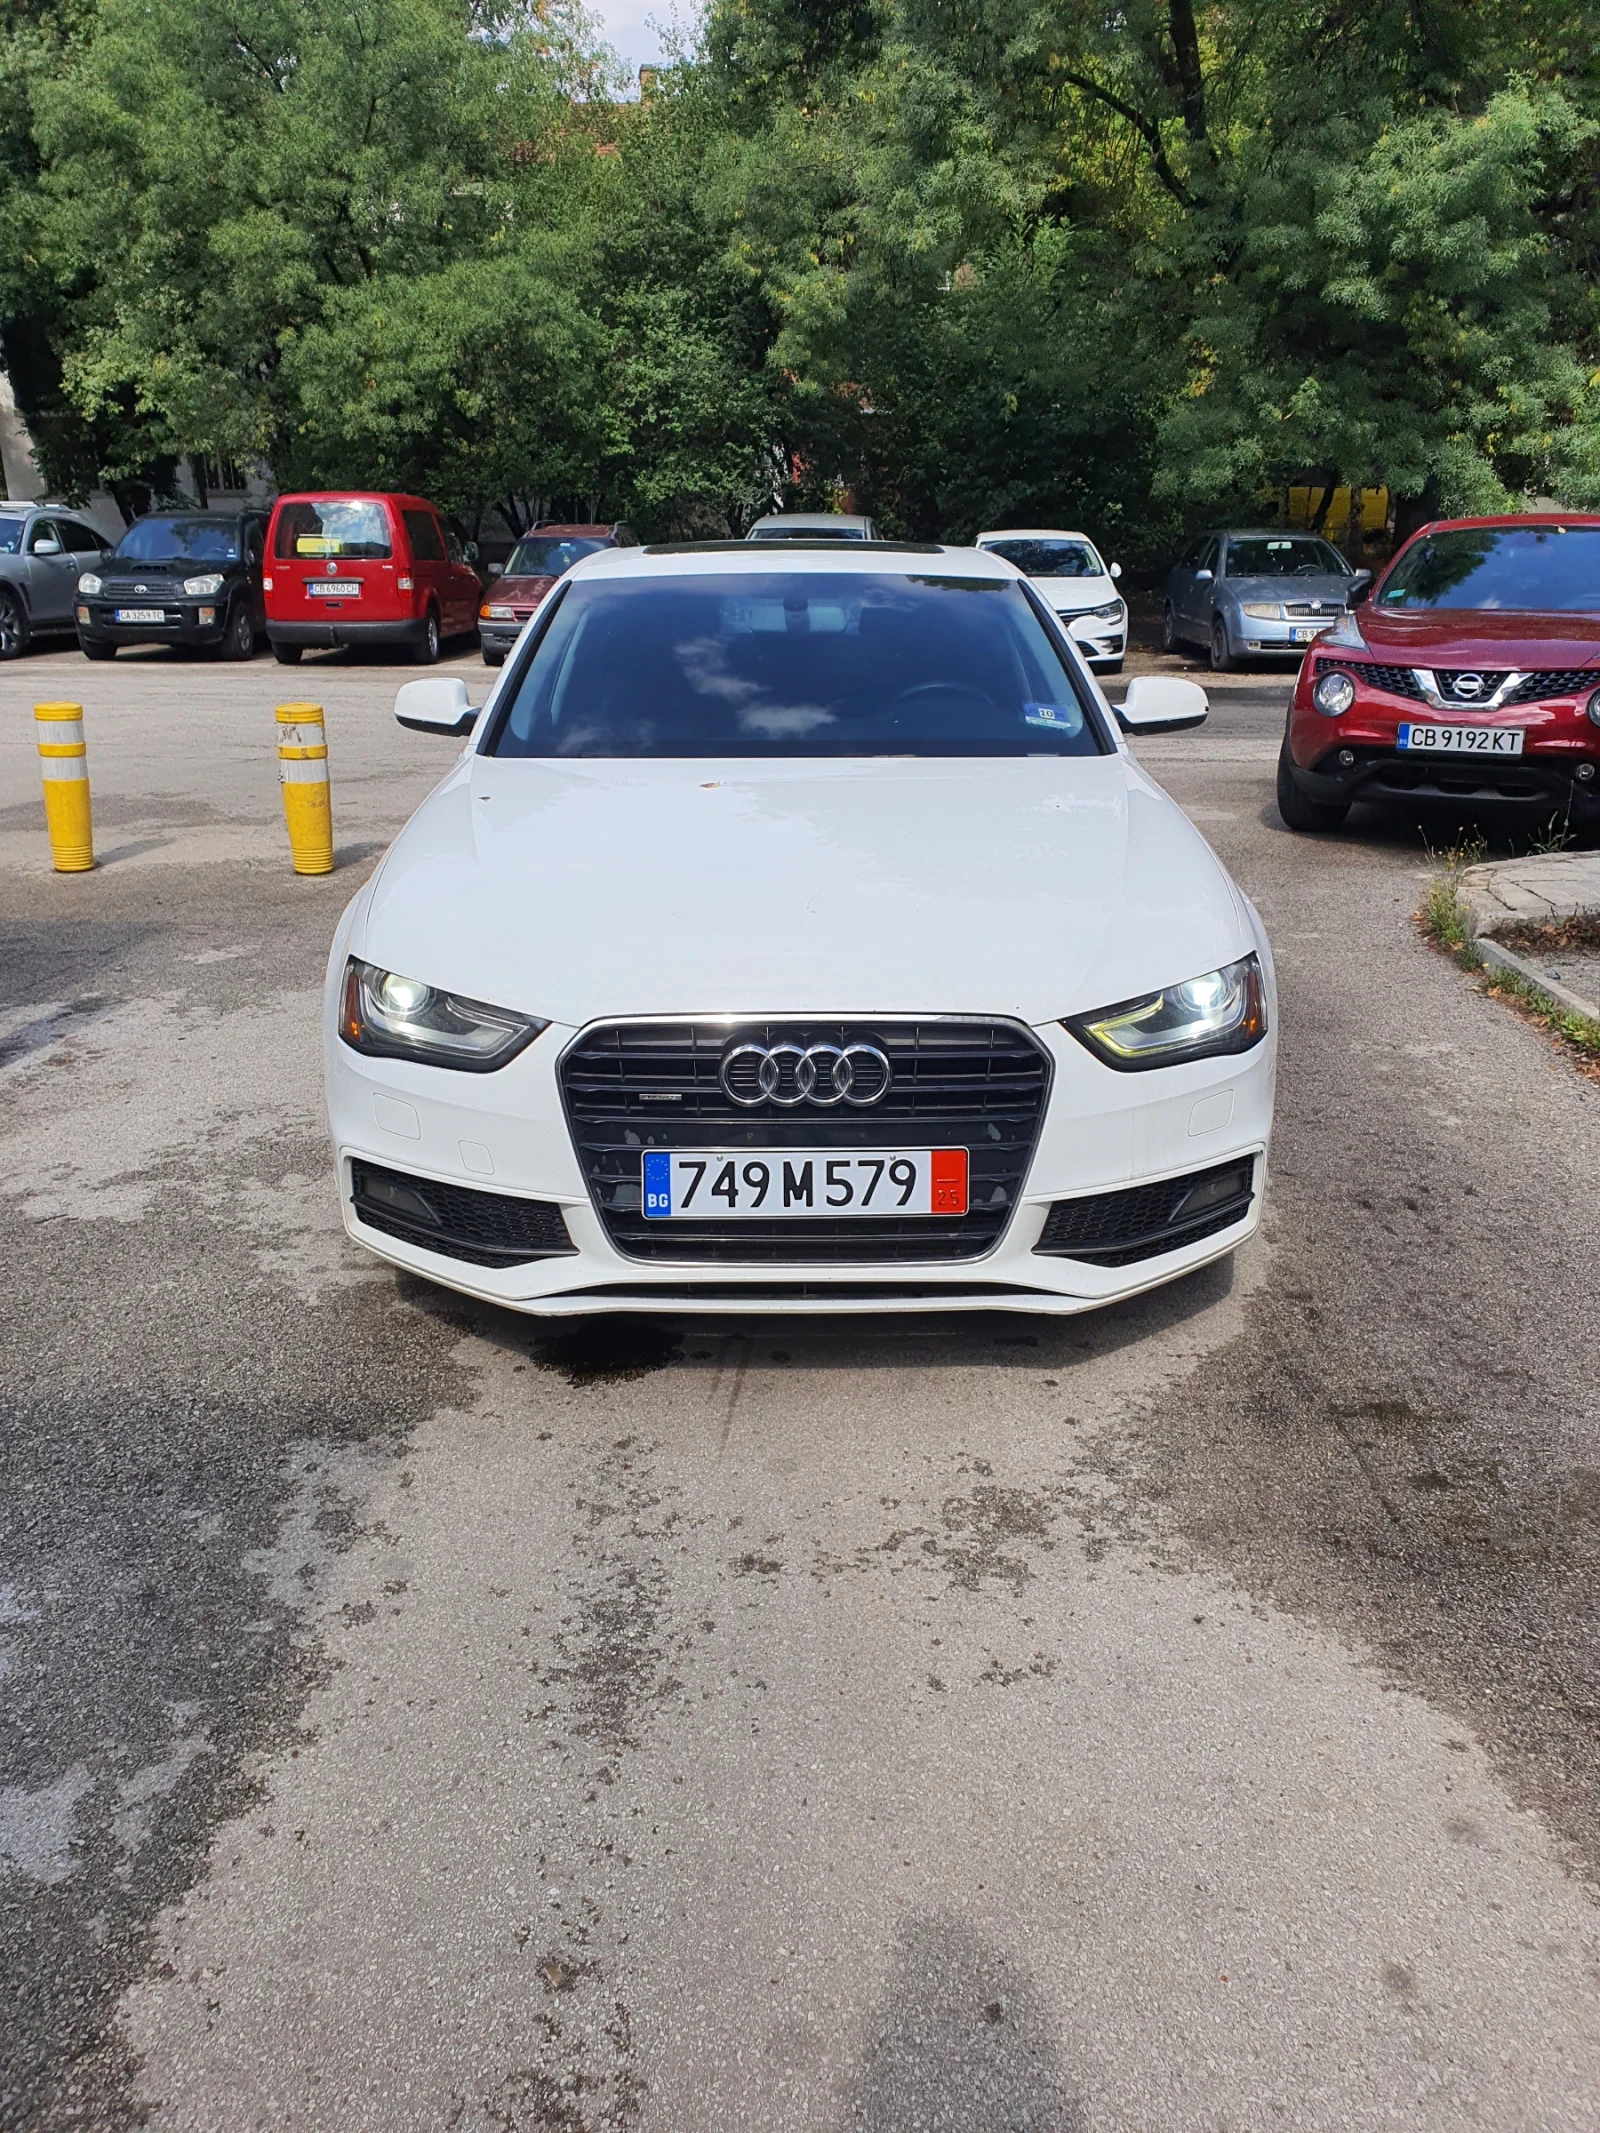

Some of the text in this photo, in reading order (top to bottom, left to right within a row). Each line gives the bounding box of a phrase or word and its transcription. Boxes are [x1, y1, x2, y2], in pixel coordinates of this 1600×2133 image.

[120, 611, 131, 620] CA
[1040, 709, 1053, 718] 10
[1411, 728, 1521, 751] CB 9192 KT
[678, 1158, 917, 1209] 749 M 579
[647, 1193, 669, 1208] BG
[937, 1189, 959, 1206] 25
